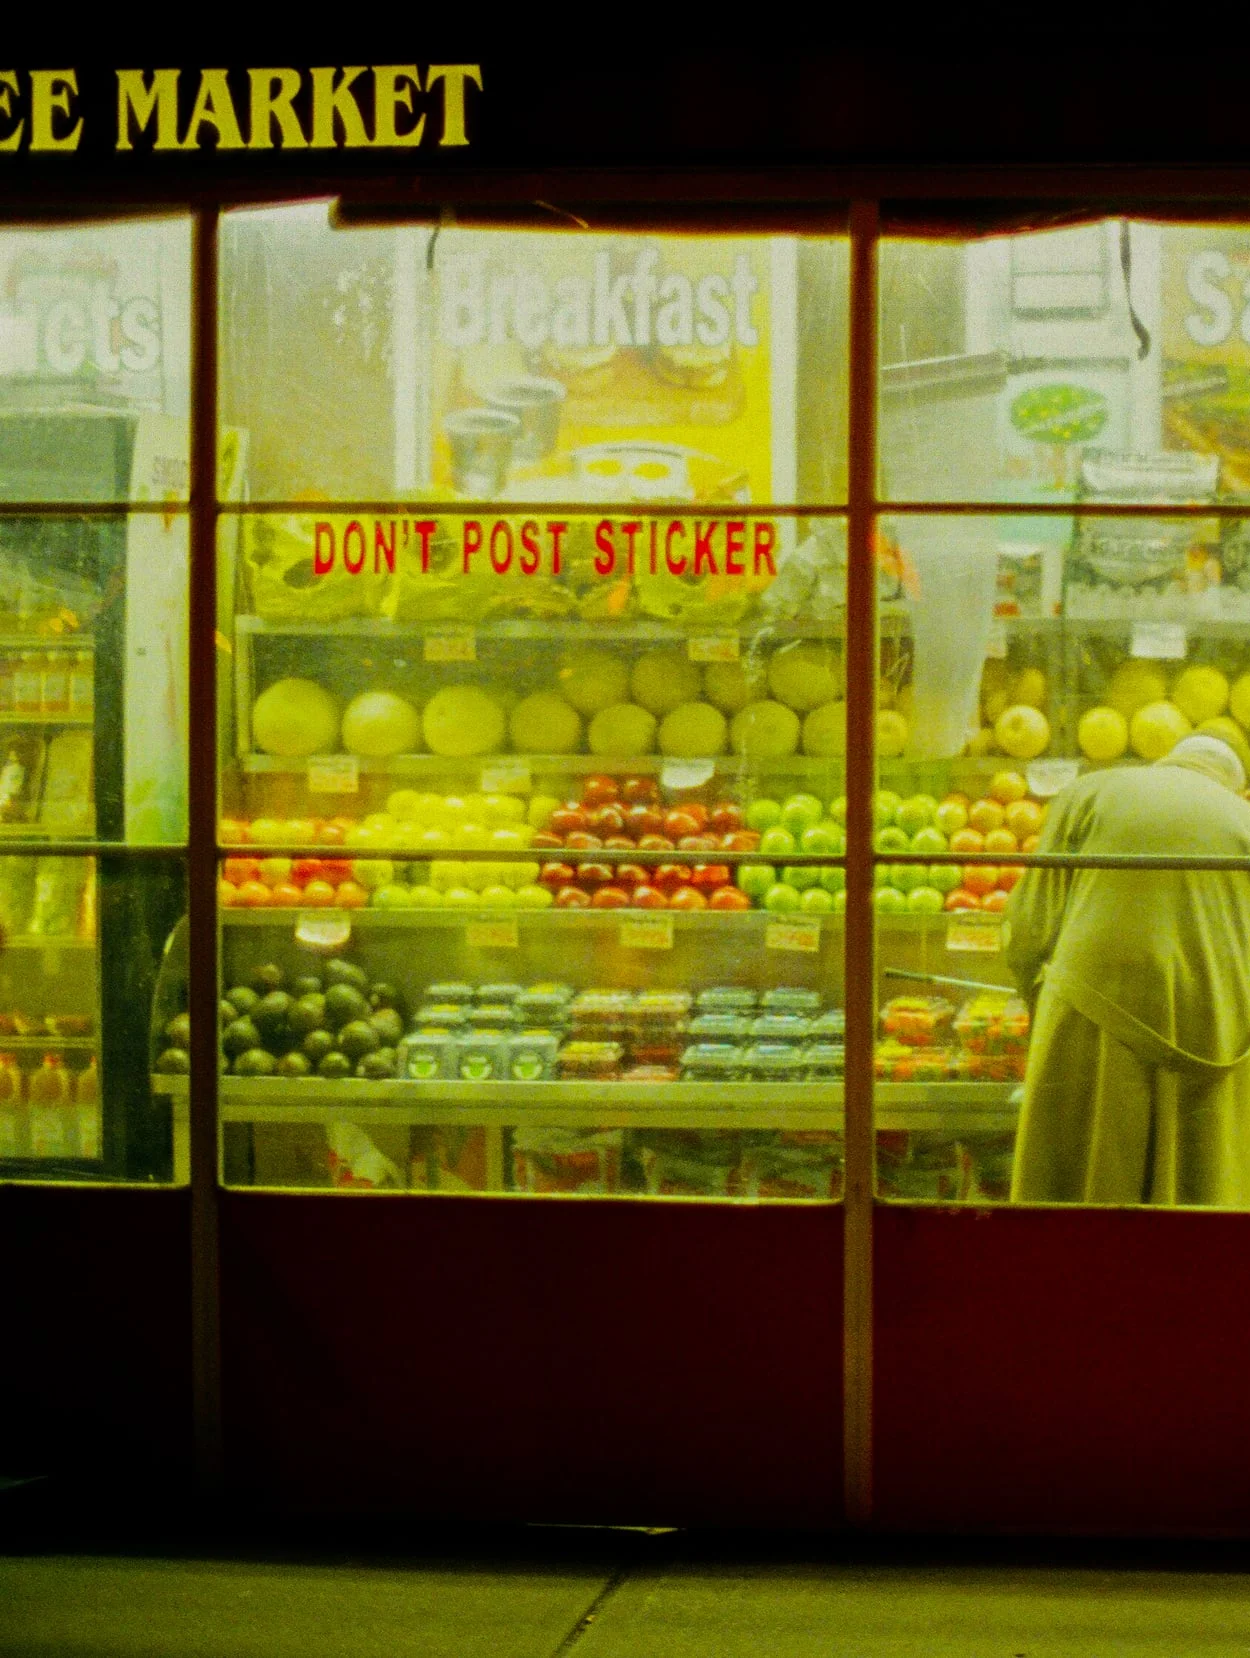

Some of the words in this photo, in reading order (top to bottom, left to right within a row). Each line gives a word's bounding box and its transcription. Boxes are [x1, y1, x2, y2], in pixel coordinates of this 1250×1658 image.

[115, 64, 483, 150] MARKET
[440, 248, 758, 347] Breakfast
[314, 519, 438, 575] DON'T
[463, 519, 568, 575] POST
[594, 519, 777, 576] STICKER
